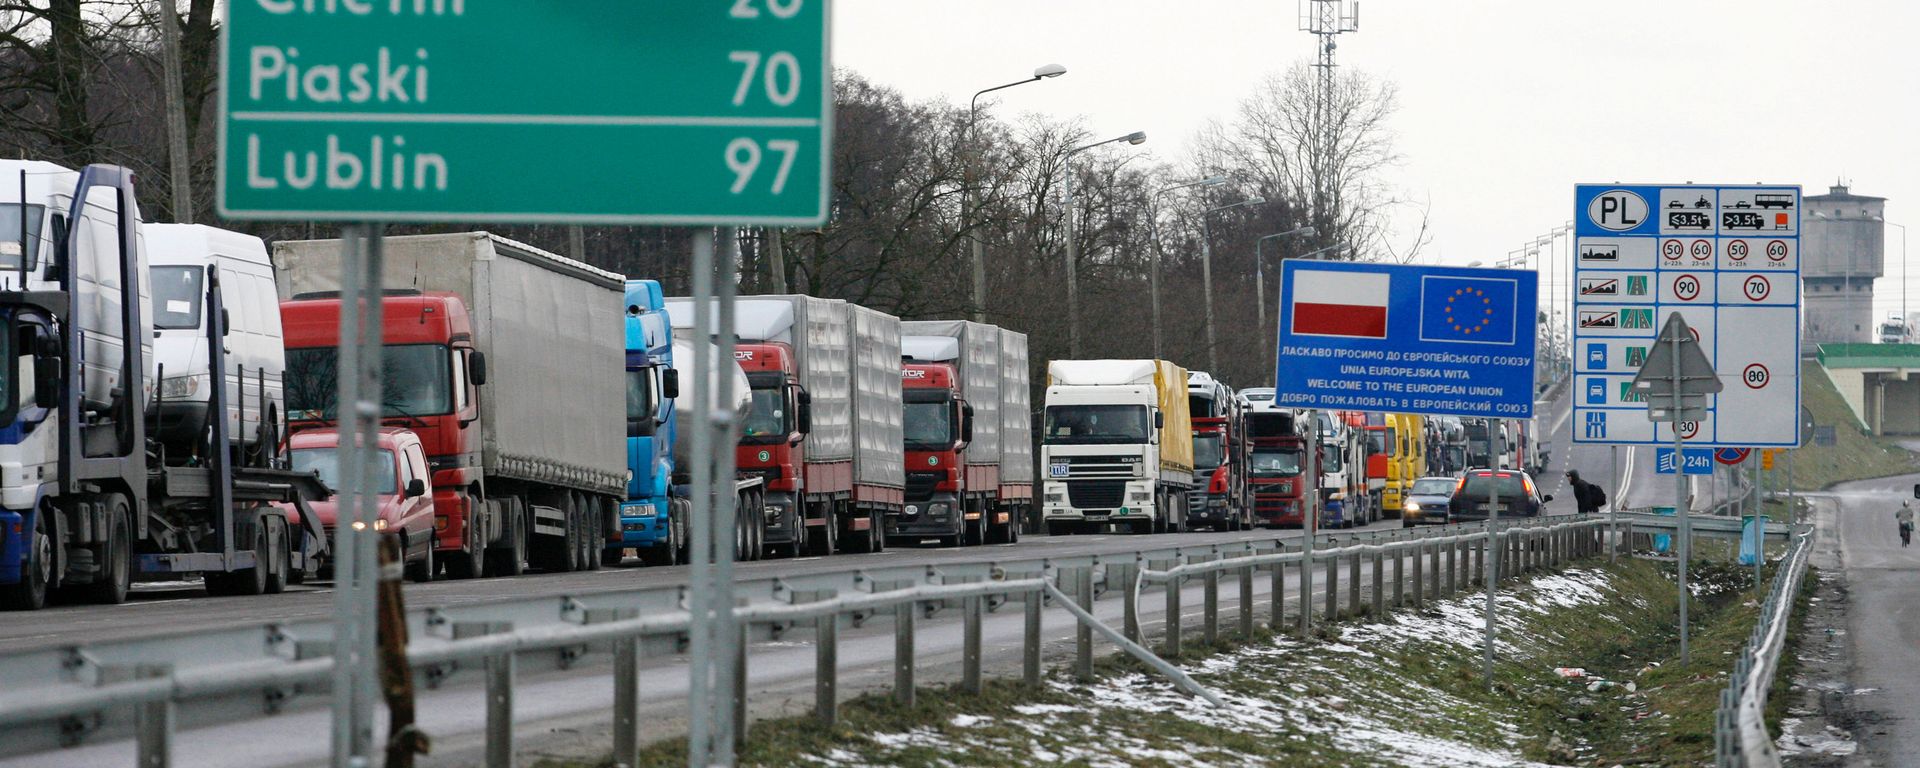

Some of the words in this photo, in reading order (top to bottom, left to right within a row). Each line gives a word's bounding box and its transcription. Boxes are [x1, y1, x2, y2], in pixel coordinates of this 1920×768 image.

[249, 45, 429, 103] Piaski
[728, 51, 802, 107] 70
[246, 133, 449, 191] Lublin
[724, 137, 801, 195] 97
[1601, 196, 1637, 225] PL
[1666, 244, 1681, 255] 50
[1694, 244, 1709, 255] 60
[1731, 244, 1746, 255] 50
[1770, 245, 1785, 256] 60
[1679, 281, 1695, 294] 90
[1750, 282, 1765, 294] 70
[1281, 346, 1332, 358] ЛАСКАВО
[1334, 348, 1384, 360] ПРОСИМО
[1386, 351, 1401, 361] ДО
[1493, 356, 1531, 366] СОЮЗУ
[1340, 365, 1367, 375] UNIA
[1369, 366, 1441, 378] EUROPEJSKA
[1443, 369, 1470, 379] WITA
[1748, 371, 1765, 383] 80
[1307, 379, 1362, 390] WELCOME
[1365, 381, 1380, 391] TO
[1382, 382, 1403, 392] THE
[1406, 383, 1466, 395] EUROPEAN
[1469, 386, 1504, 396] UNION
[1280, 393, 1316, 404] ДОБРО
[1320, 395, 1398, 407] ПОЖАЛОВАТЬ
[1401, 399, 1409, 408] В
[1413, 399, 1491, 411] ЕВРОПЕЙСКИЙ
[1496, 403, 1528, 413] СОЮЗ
[1680, 421, 1695, 432] 30
[1688, 455, 1710, 467] 24h
[1054, 465, 1067, 475] TIR
